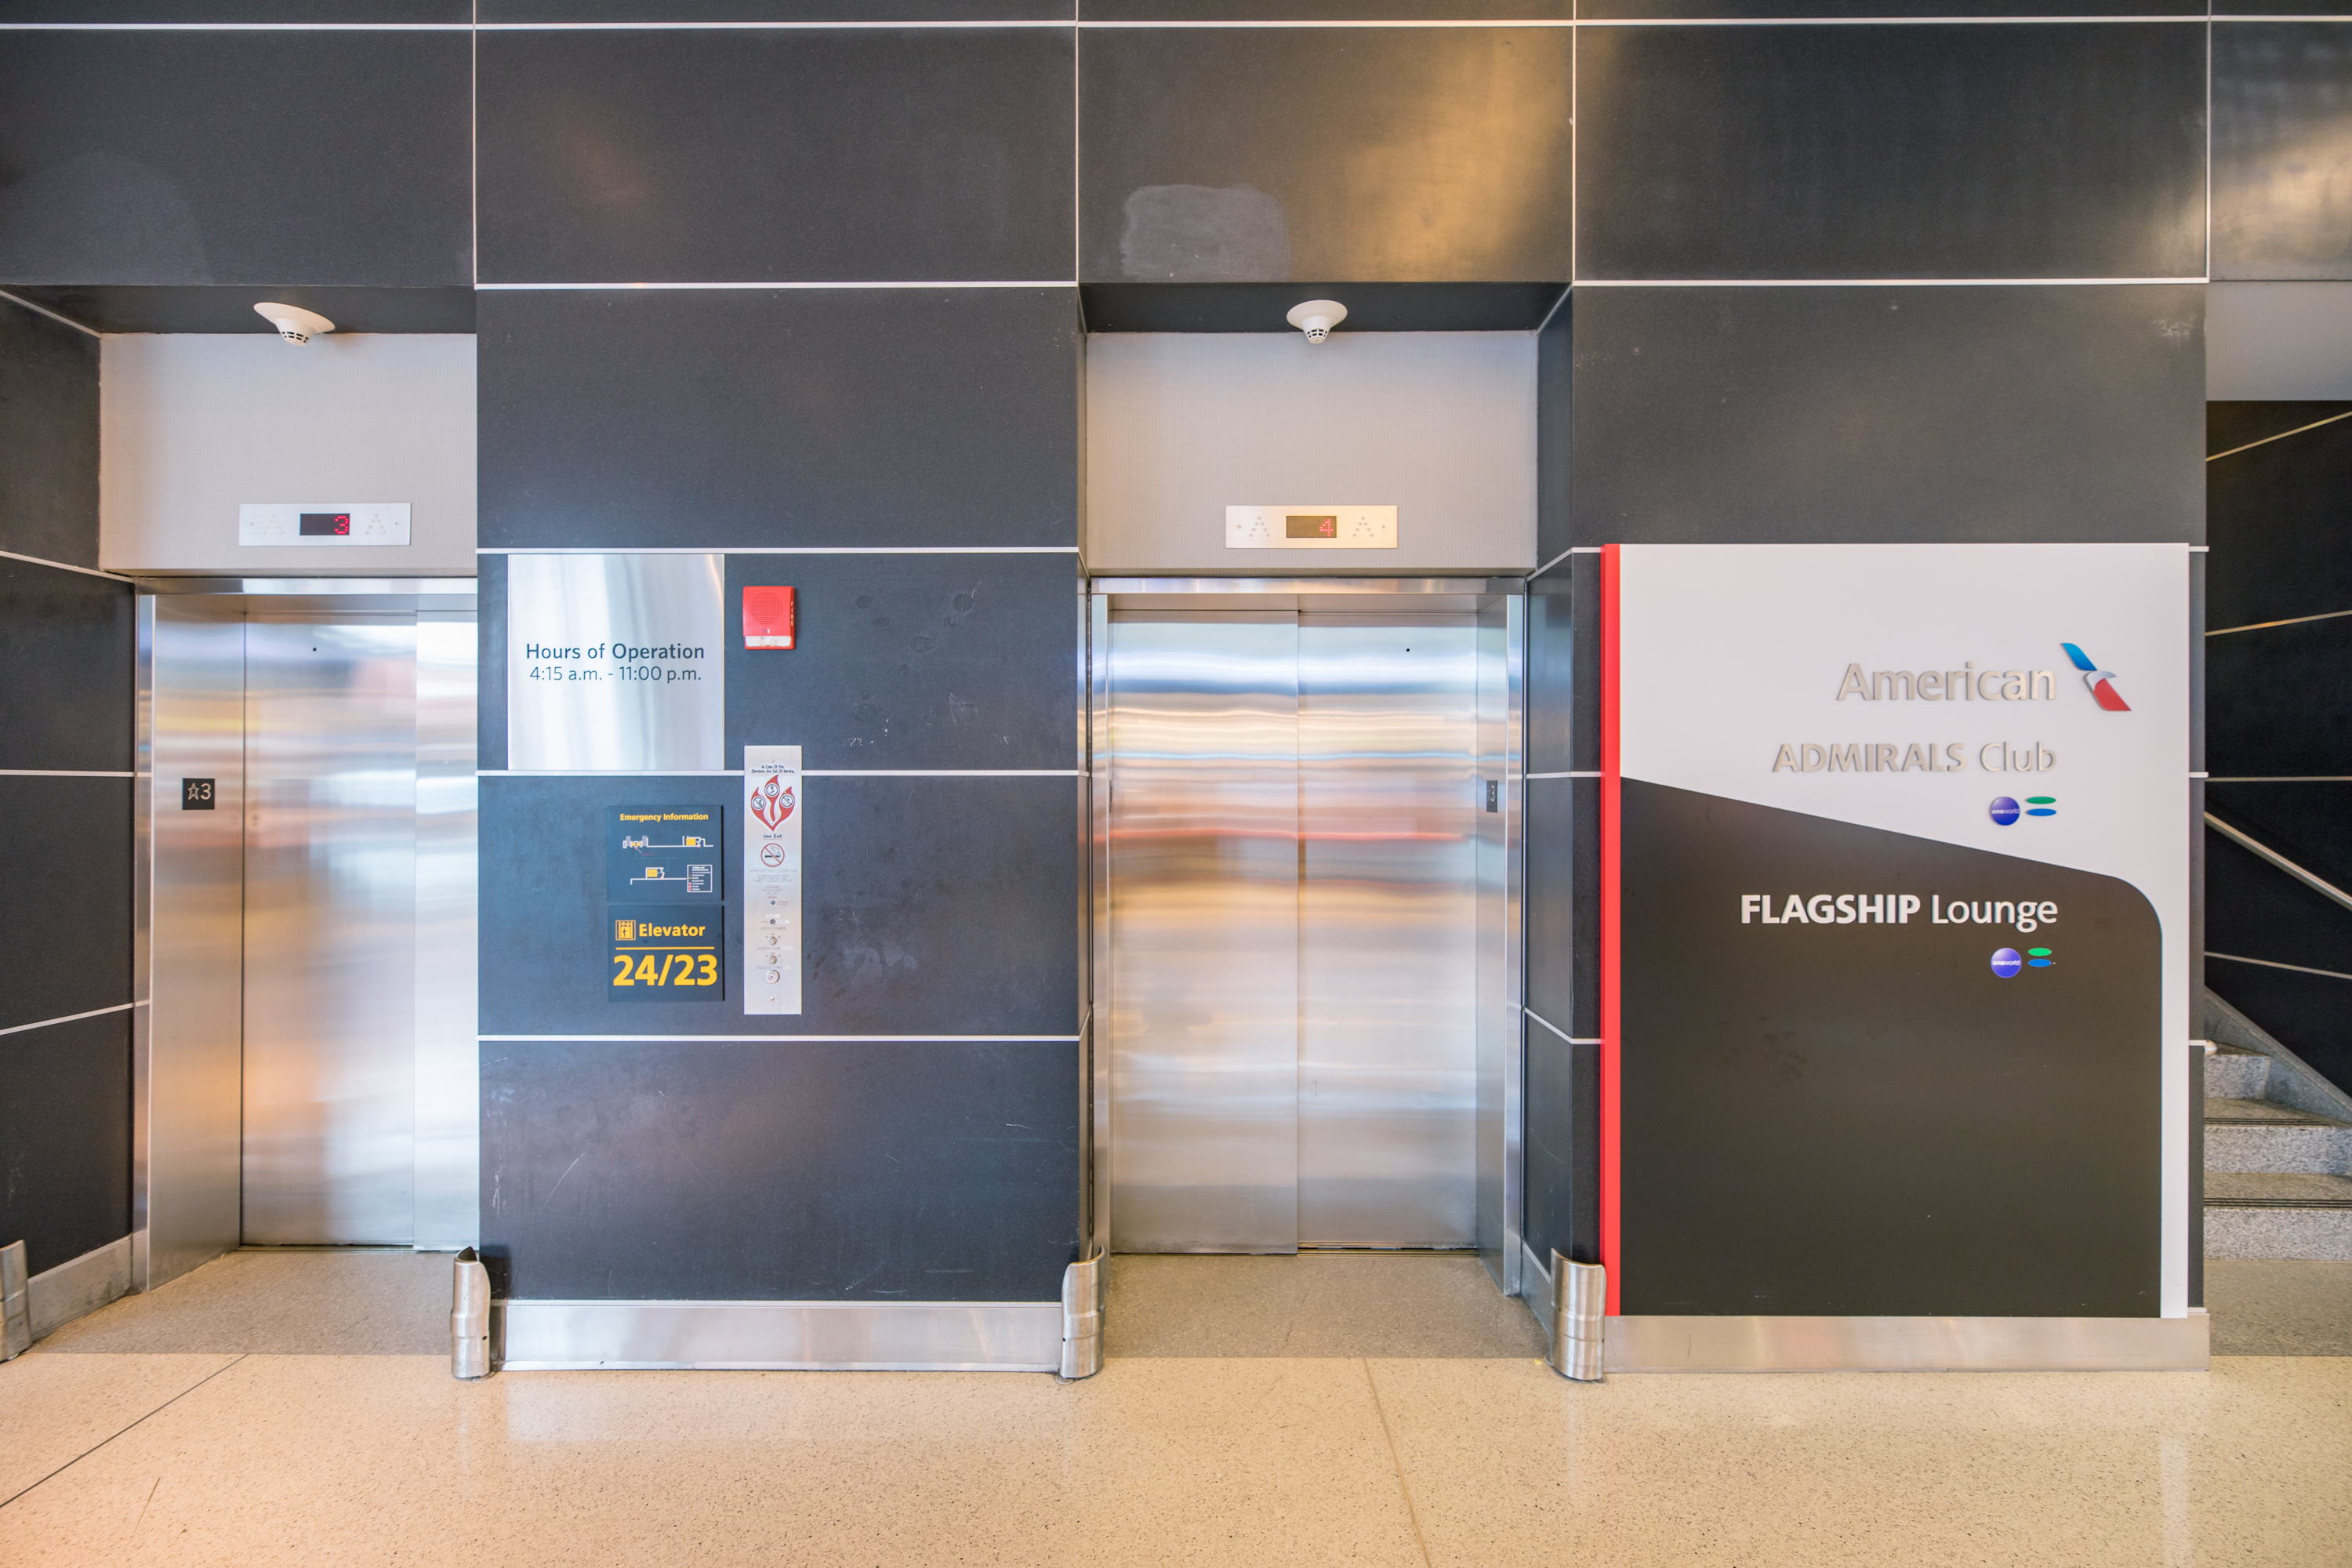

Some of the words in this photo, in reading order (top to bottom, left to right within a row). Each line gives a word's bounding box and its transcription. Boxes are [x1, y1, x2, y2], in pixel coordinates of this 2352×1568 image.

[334, 515, 349, 535] 3
[1319, 518, 1334, 537] 4
[526, 643, 581, 659] Hours
[587, 643, 605, 659] of
[612, 643, 705, 662] Operation
[529, 666, 563, 681] 4:15
[568, 670, 602, 681] a.m.
[619, 666, 662, 681] 11:00
[666, 669, 702, 684] p.m.
[1836, 661, 2057, 701] American
[1772, 742, 1968, 772] ADMIRALS
[1980, 741, 2057, 772] Club
[200, 782, 212, 800] 3
[1490, 785, 1496, 803] 3
[619, 813, 662, 822] Emergency
[1740, 894, 1921, 924] FLAGSHIP
[1931, 894, 2059, 933] Lounge
[639, 923, 706, 937] Elevator
[613, 954, 718, 986] 24/23
